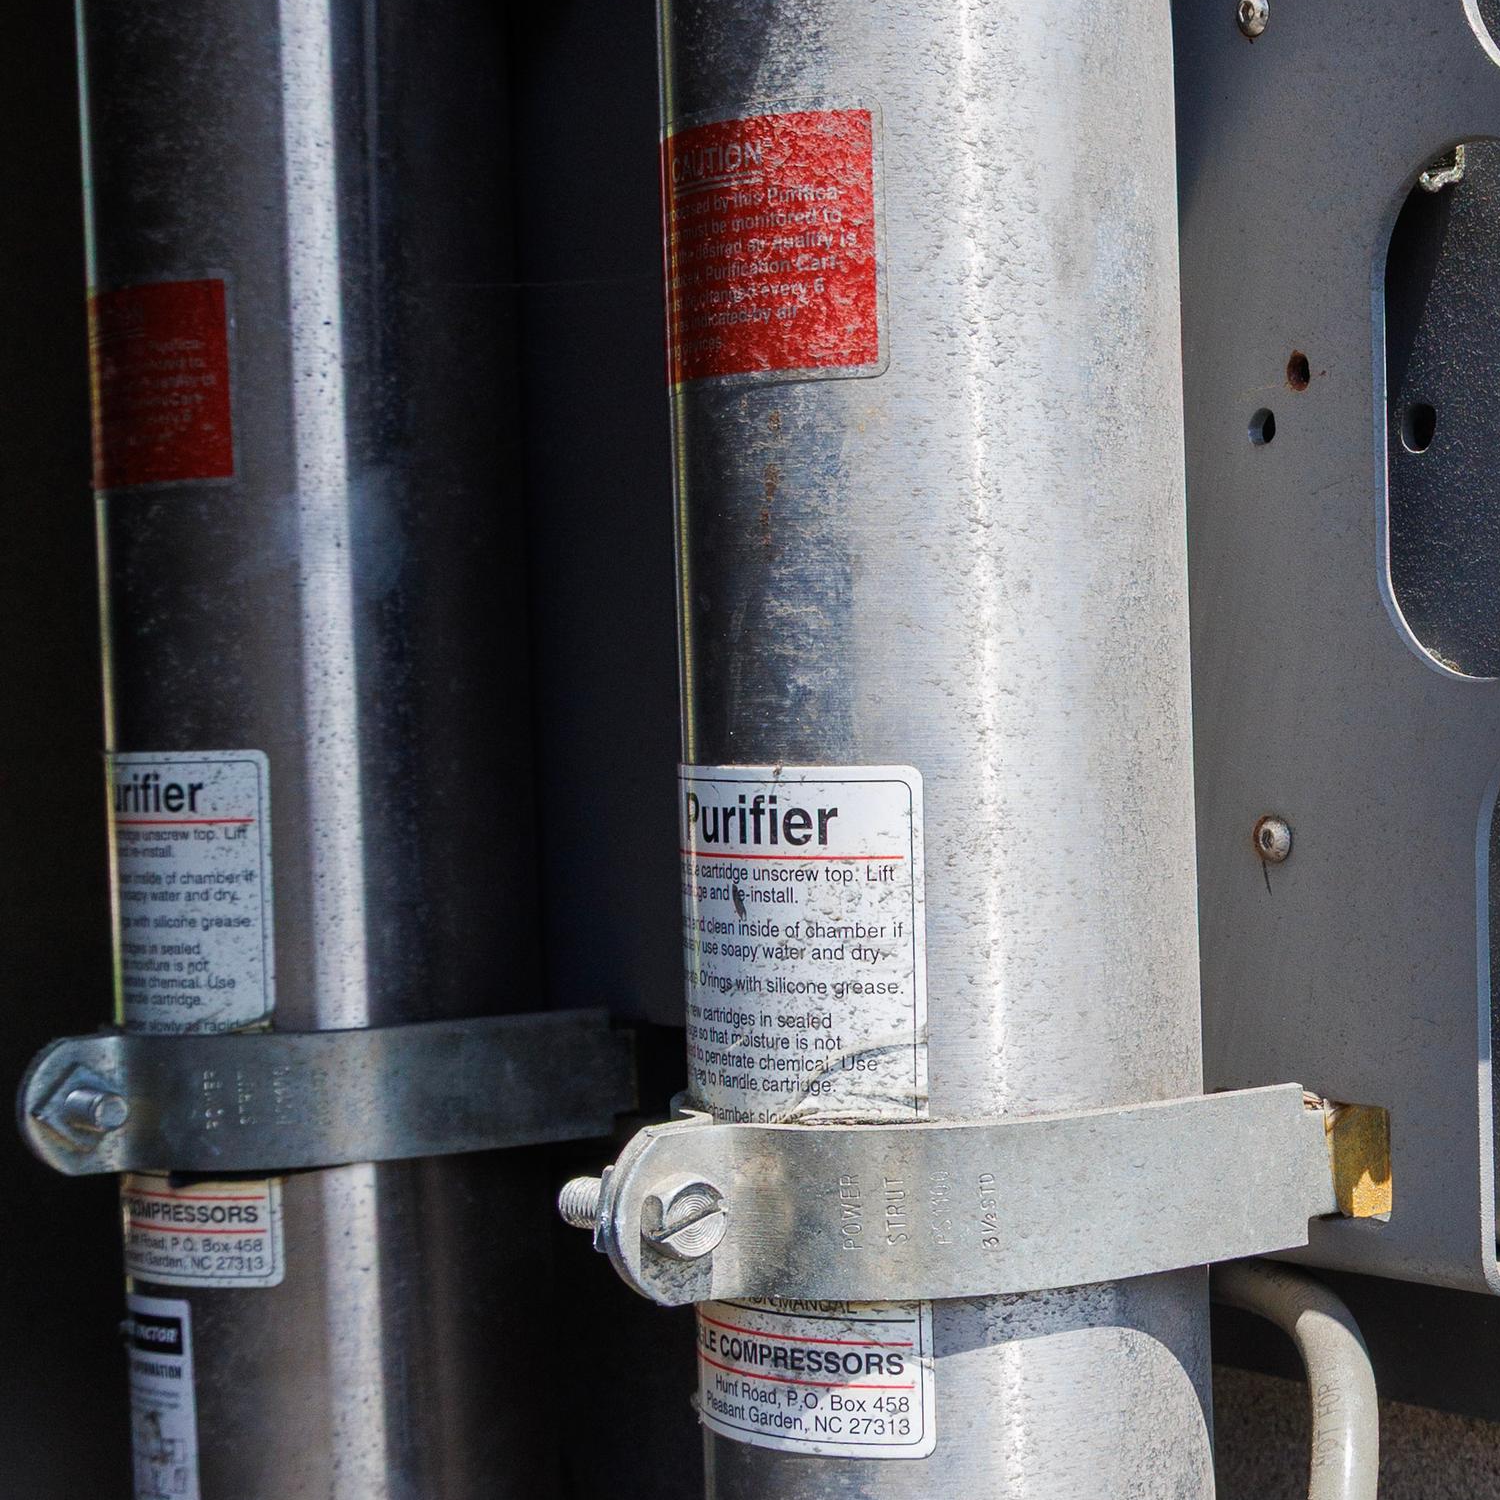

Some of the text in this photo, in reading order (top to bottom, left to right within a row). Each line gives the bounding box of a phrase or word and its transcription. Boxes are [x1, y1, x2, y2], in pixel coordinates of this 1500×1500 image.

[672, 139, 764, 184] CAUTION
[732, 208, 817, 233] monitored
[822, 205, 843, 224] to
[839, 227, 857, 248] is
[116, 774, 204, 813] rifier
[686, 791, 838, 846] Purifier
[701, 863, 748, 884] cartridge
[752, 867, 819, 882] unscrew
[825, 866, 859, 885] top.
[866, 864, 895, 882] Lift
[710, 884, 730, 901] and
[708, 917, 735, 936] clean
[738, 920, 780, 938] inside
[785, 921, 801, 938] of
[805, 922, 887, 938] chamber
[892, 921, 904, 938] if
[701, 941, 886, 964] use soapy water and dry.
[735, 975, 762, 993] with
[766, 976, 827, 994] silicone
[833, 981, 904, 999] grease.
[703, 1006, 755, 1029] cartridges
[759, 1010, 773, 1028] in
[776, 1012, 832, 1030] sealed
[709, 1026, 842, 1051] that moisture is not
[704, 1049, 878, 1073] penetrate chemical. Use
[708, 1069, 837, 1097] to handle cartridge.
[839, 1173, 864, 1250] POWER
[883, 1176, 910, 1246] STRUT
[190, 1256, 265, 1272] NC 27313
[719, 1333, 905, 1376] COMPRESSORS
[715, 1373, 910, 1413] Hunt Road, P.O. Box 458
[706, 1389, 911, 1436] Pleasant Garden, NC 27313
